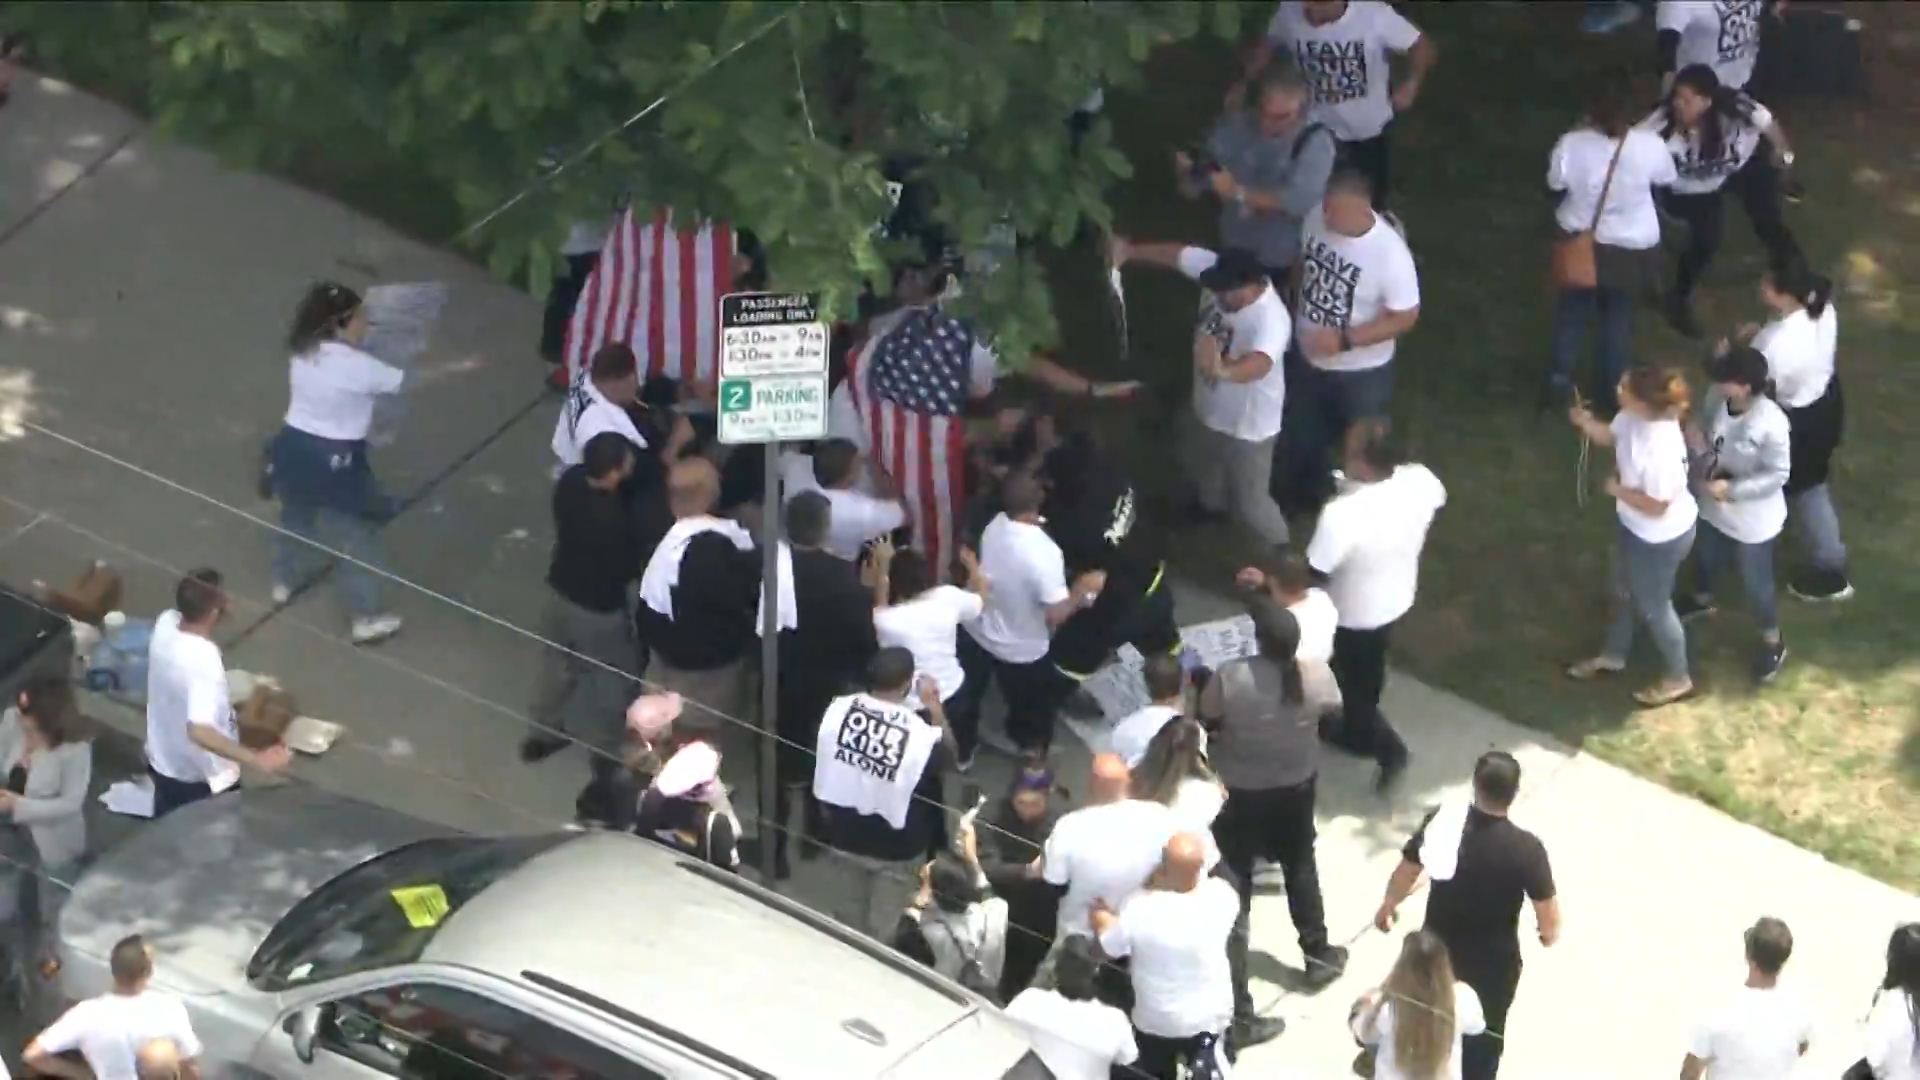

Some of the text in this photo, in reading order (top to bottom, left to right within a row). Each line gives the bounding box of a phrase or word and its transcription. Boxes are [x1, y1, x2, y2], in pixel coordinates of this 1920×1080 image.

[1296, 40, 1365, 59] LEAVE
[1304, 234, 1362, 282] LEAVE
[1303, 259, 1348, 295] OUR
[733, 309, 815, 323] LOADING ONLY
[741, 295, 809, 309] PASSENGER
[728, 386, 819, 409] 2 PARKING
[841, 726, 899, 768] KIDS
[848, 711, 905, 750] OUR
[834, 748, 897, 782] ALONE
